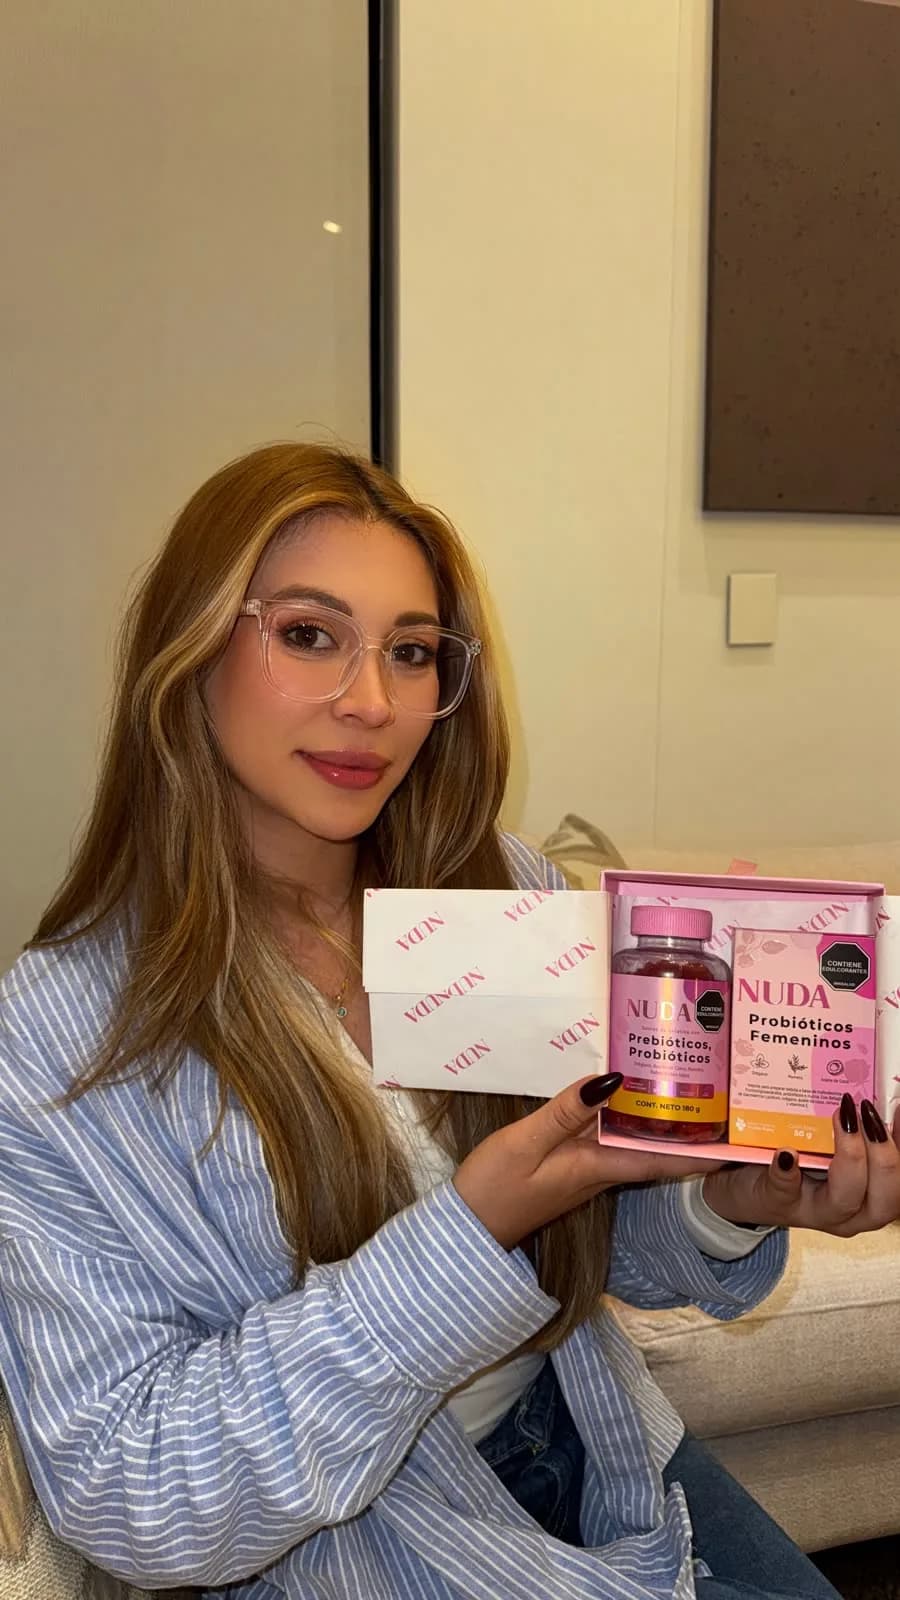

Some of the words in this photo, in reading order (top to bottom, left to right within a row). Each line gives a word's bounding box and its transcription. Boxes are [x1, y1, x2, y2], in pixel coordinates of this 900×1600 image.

[396, 911, 445, 951] NUDA
[545, 936, 596, 978] NUDA
[827, 960, 863, 969] CONTIENE
[737, 978, 830, 1008] NUDA
[626, 998, 692, 1022] NUDA
[550, 1012, 600, 1052] NUDA
[749, 1013, 853, 1032] Probióticos
[628, 1033, 712, 1051] Prebióticos,
[751, 1030, 851, 1049] Femeninos
[444, 1038, 491, 1076] NUDA
[629, 1046, 711, 1063] Probióticos
[635, 1099, 658, 1108] CONT.
[660, 1102, 681, 1111] NETO
[695, 1106, 701, 1114] g
